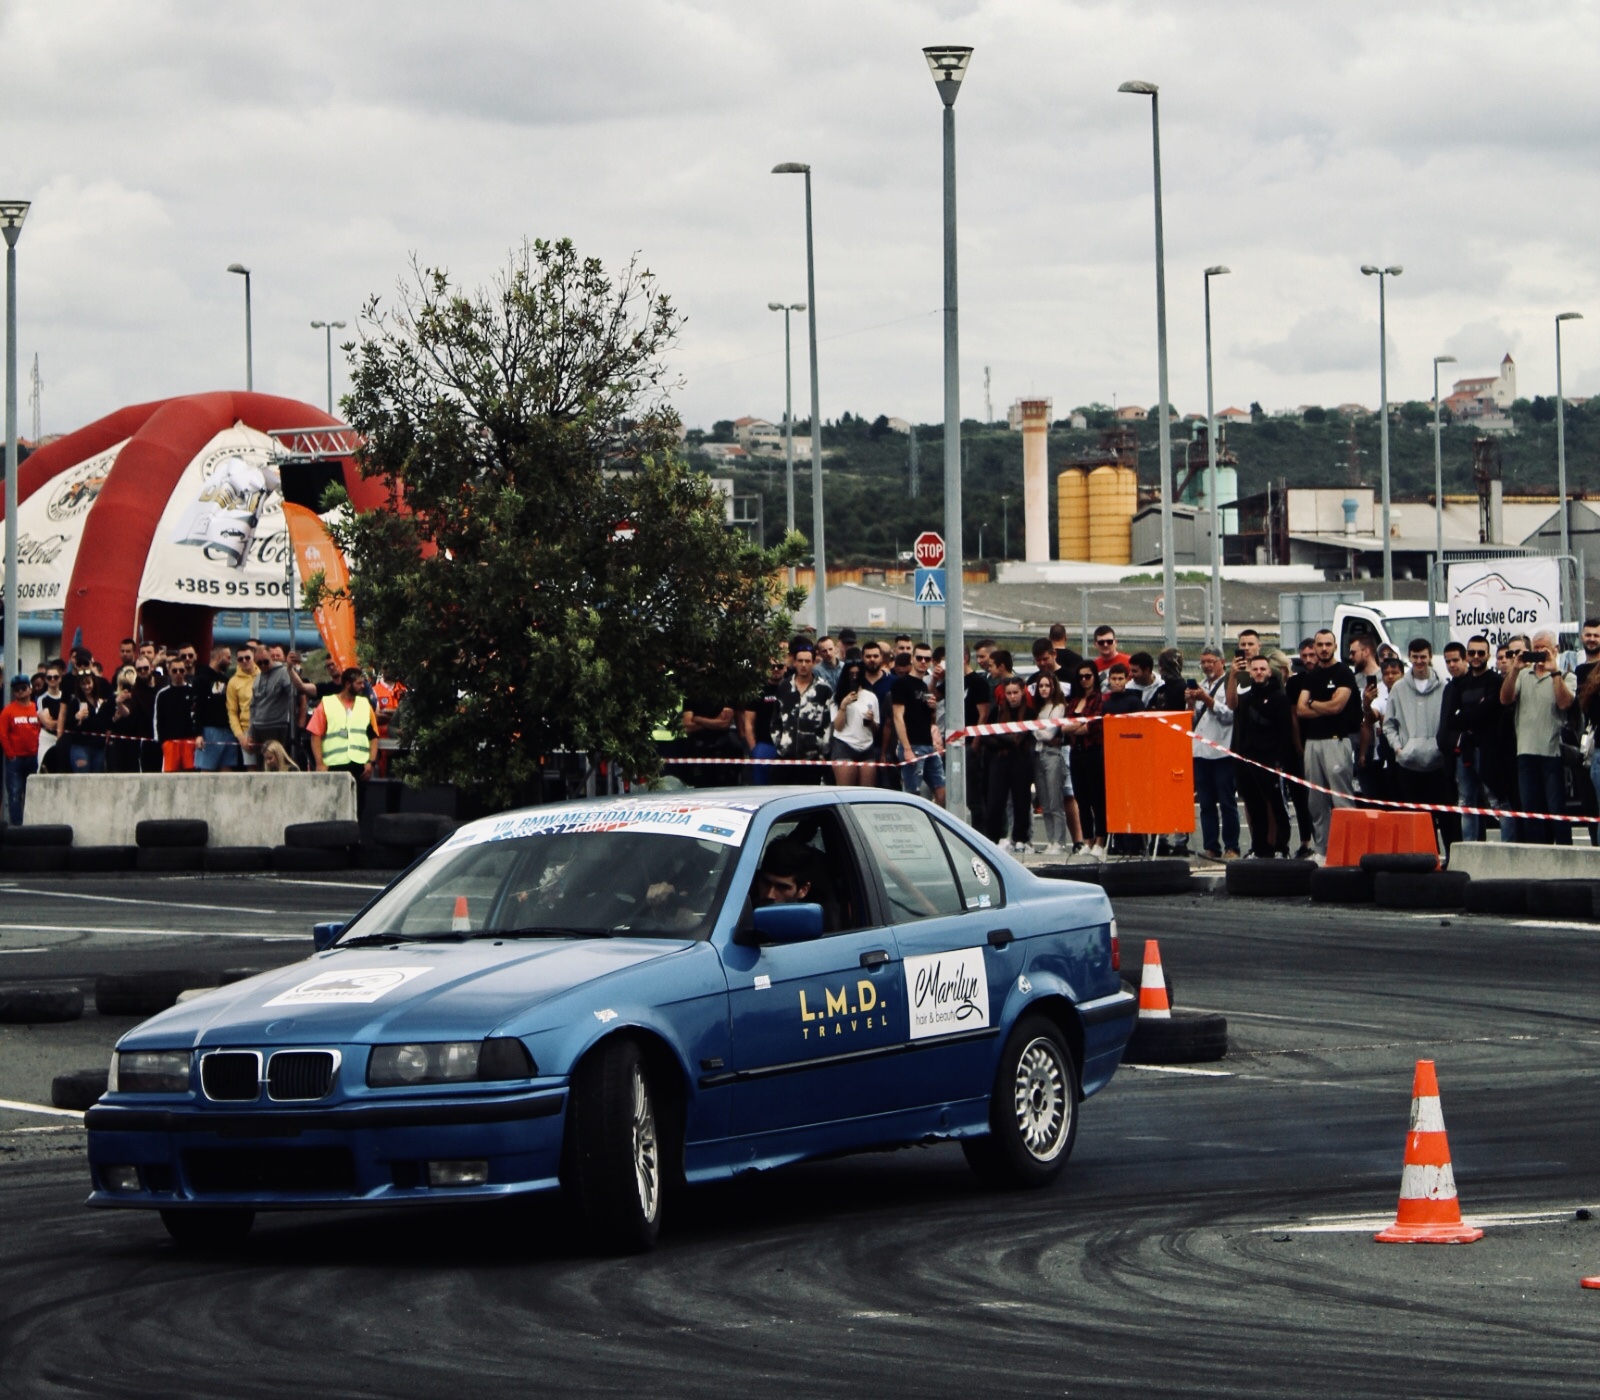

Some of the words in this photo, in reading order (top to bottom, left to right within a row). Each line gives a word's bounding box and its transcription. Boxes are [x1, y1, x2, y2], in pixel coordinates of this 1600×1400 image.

[917, 543, 943, 558] STOP
[17, 584, 35, 599] 506
[175, 578, 220, 594] +385
[225, 581, 249, 596] 95
[1456, 607, 1505, 626] Exclusive
[1507, 606, 1538, 624] Cars
[518, 813, 559, 829] BMW
[559, 810, 604, 824] MEET
[605, 810, 692, 826] DALMACIJA
[914, 960, 983, 1021] Marilyn
[800, 980, 886, 1022] L.M.D.
[915, 1010, 928, 1026] hair
[929, 1011, 935, 1024] &
[935, 1009, 957, 1024] beauty
[803, 1015, 887, 1040] TRAVEL
